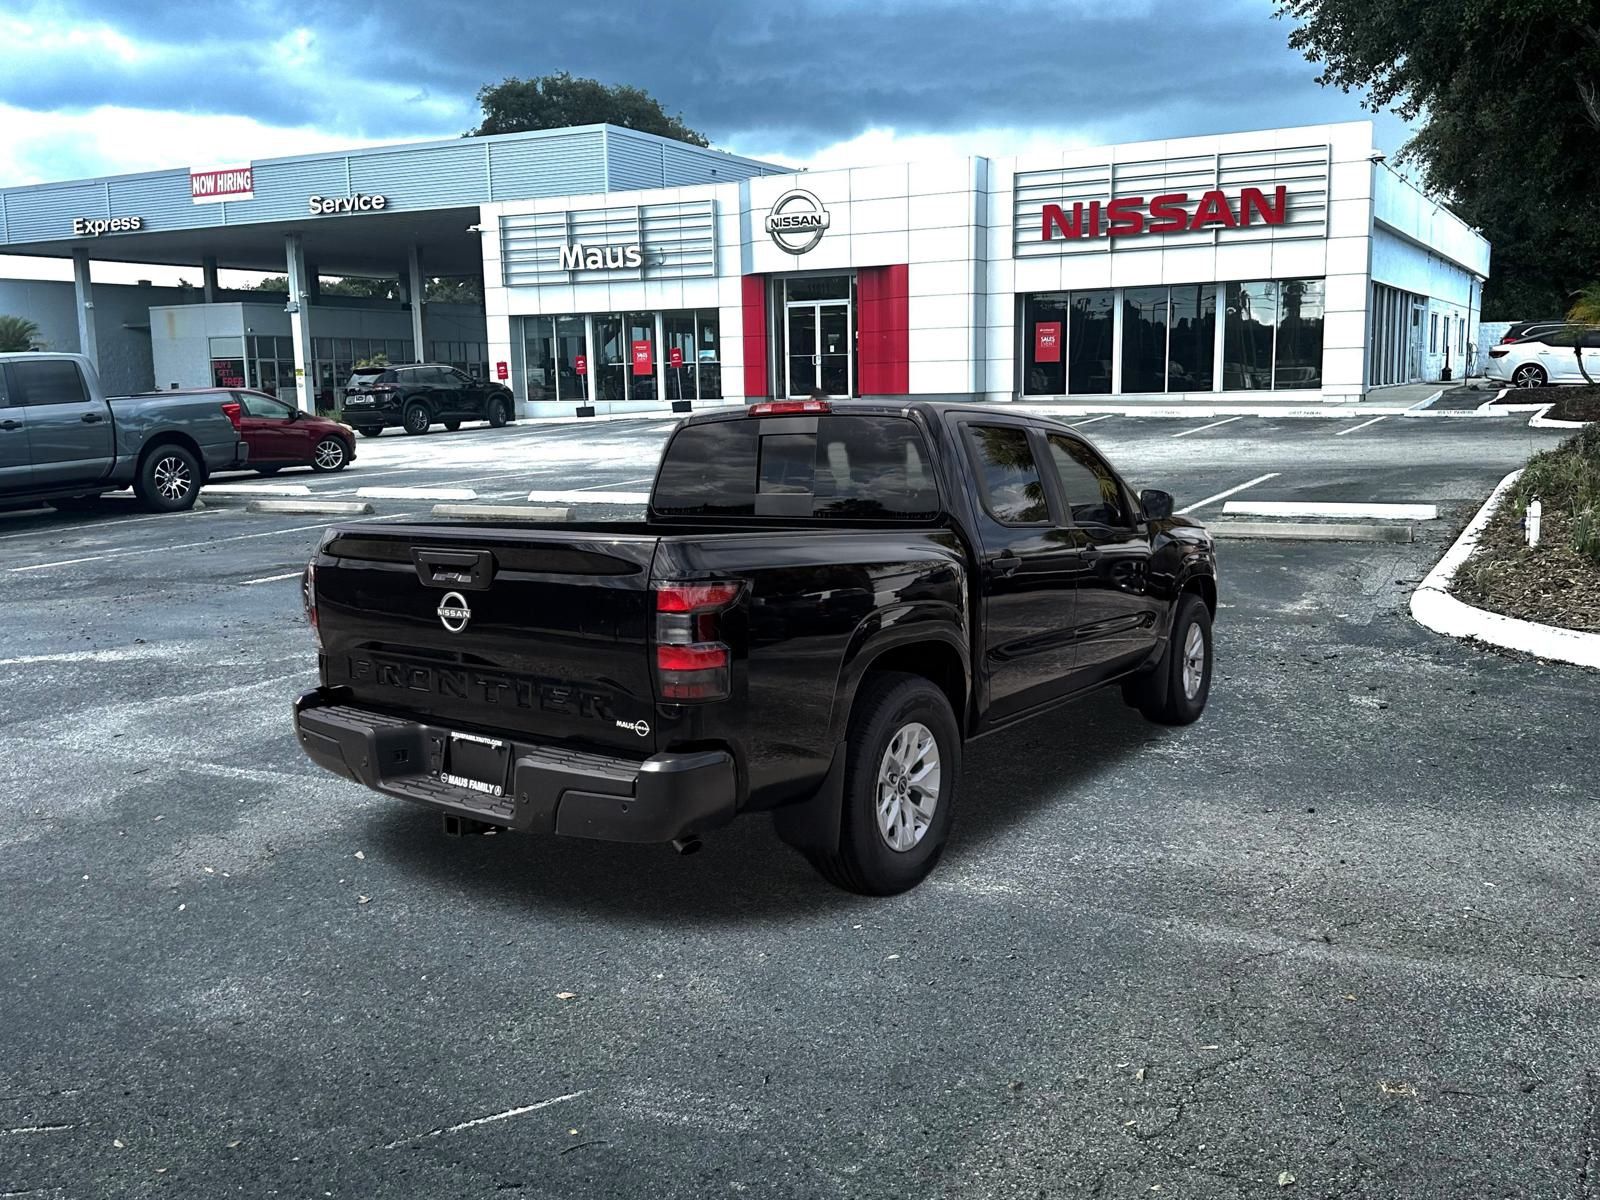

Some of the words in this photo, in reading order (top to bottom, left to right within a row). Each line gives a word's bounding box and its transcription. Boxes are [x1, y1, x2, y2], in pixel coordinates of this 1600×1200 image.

[193, 175, 215, 195] NOW
[216, 171, 251, 192] HIRING
[309, 193, 385, 214] Service
[1042, 185, 1287, 241] NISSAN
[73, 216, 141, 237] Express
[771, 215, 821, 228] NISSAN
[560, 243, 642, 271] Maus
[223, 376, 244, 387] FREE
[438, 608, 470, 618] NISSAN
[348, 655, 615, 721] FRONTIER
[616, 720, 634, 730] MAUS
[447, 774, 468, 788] MAUS
[468, 780, 495, 794] FAMILY
